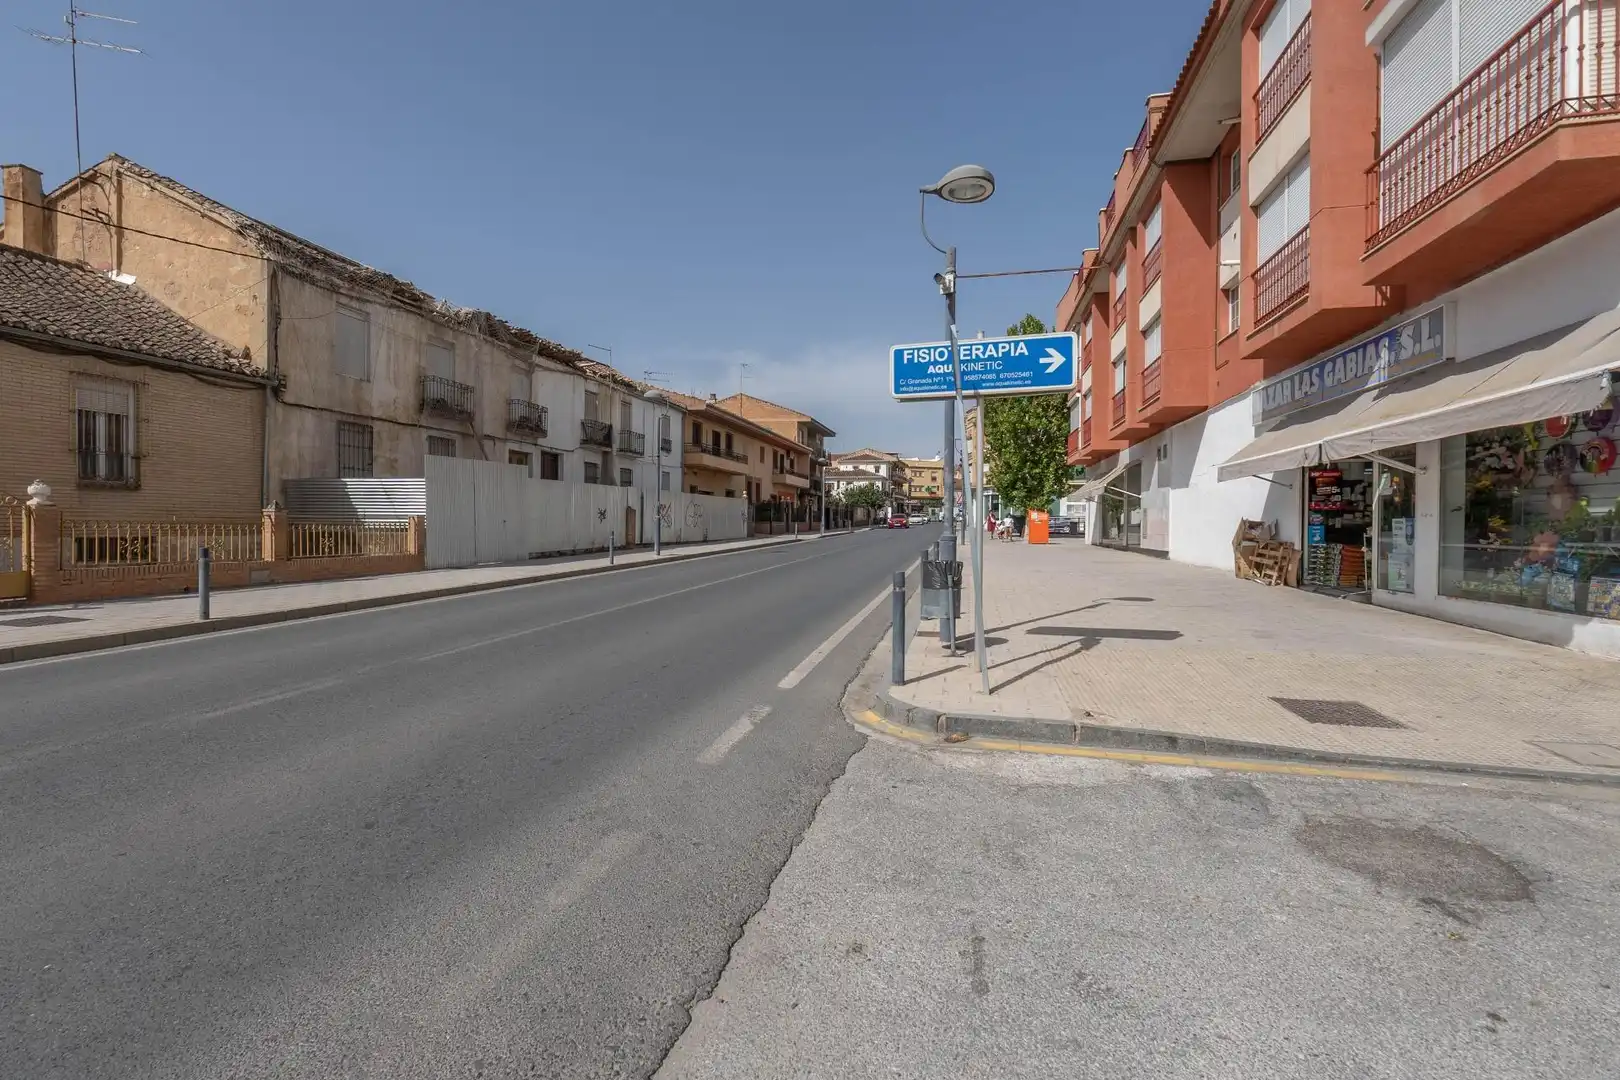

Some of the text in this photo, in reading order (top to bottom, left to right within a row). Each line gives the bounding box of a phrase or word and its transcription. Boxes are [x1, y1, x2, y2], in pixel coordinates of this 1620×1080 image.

[1294, 367, 1320, 400] LAS
[1398, 316, 1442, 361] S.L.
[927, 360, 1004, 374] AQUKINETIC
[907, 377, 932, 385] Granada
